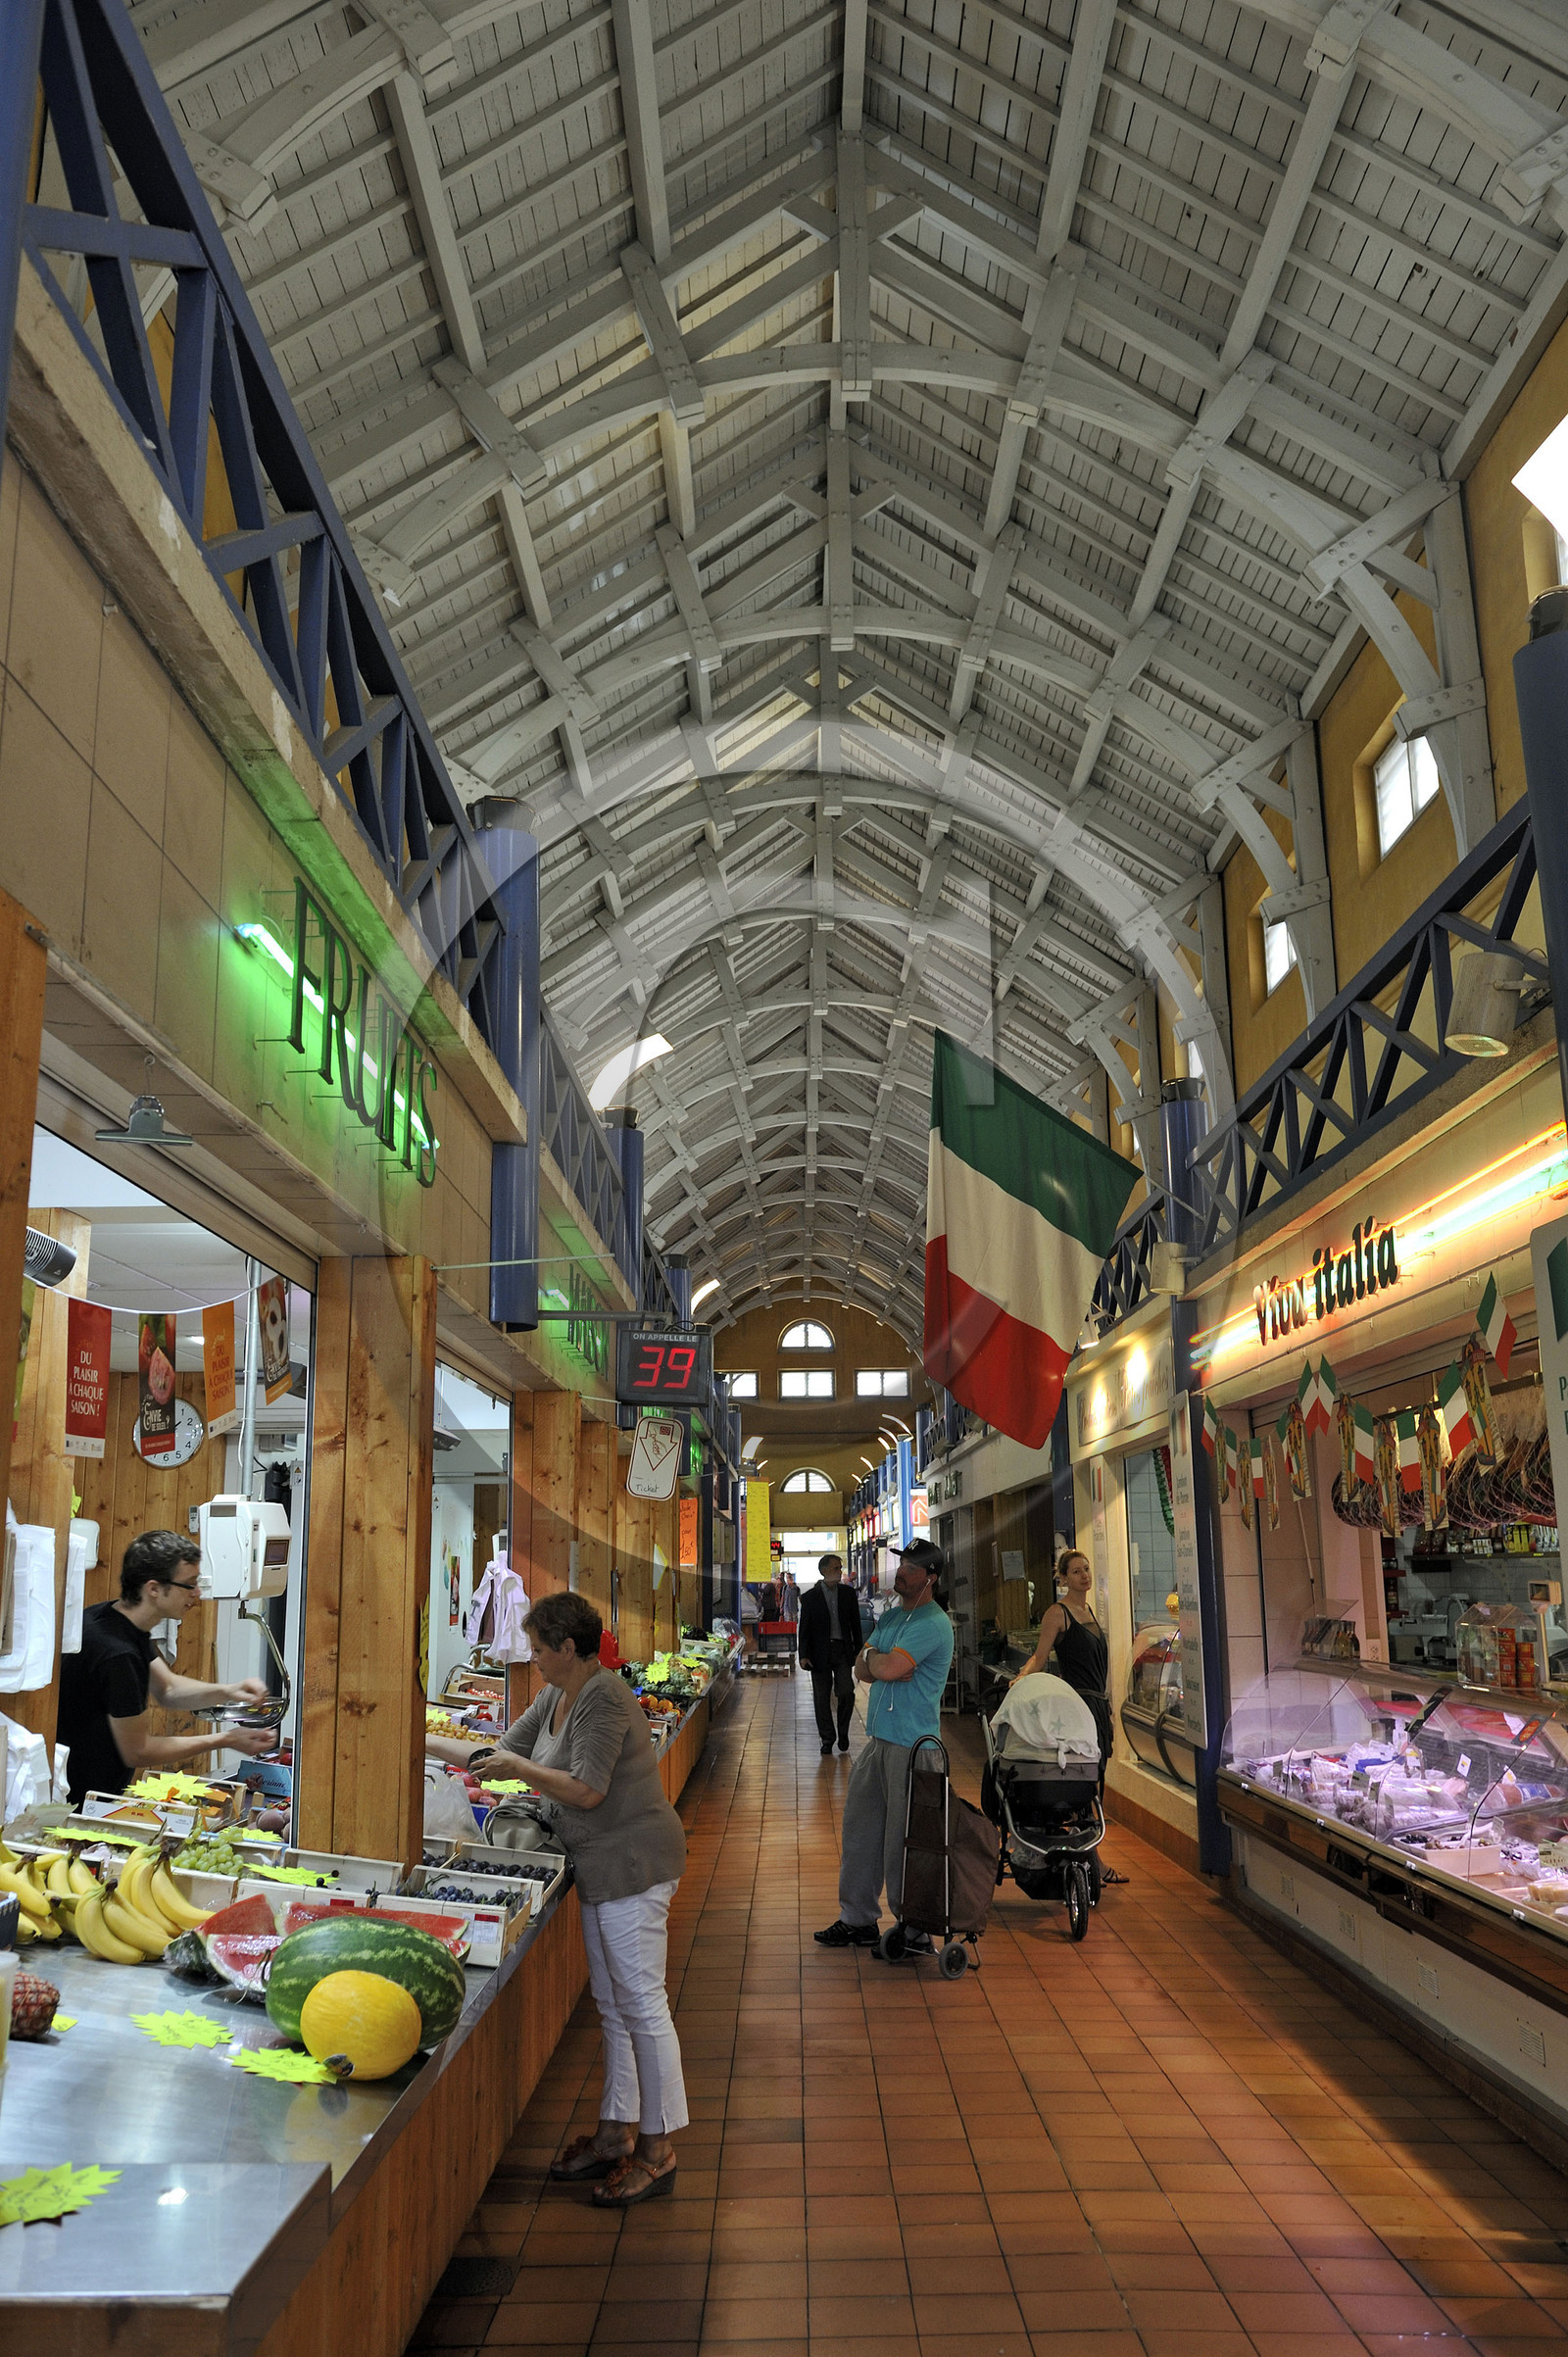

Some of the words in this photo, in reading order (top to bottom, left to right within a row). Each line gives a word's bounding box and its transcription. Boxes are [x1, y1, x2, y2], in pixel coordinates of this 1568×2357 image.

[287, 876, 437, 1189] FRUITS
[1312, 1215, 1401, 1320] italia
[647, 1333, 685, 1342] APPELLE
[80, 1350, 92, 1365] DU
[74, 1366, 99, 1383] PLAISIR
[632, 1346, 697, 1389] 39
[73, 1383, 104, 1401] CHAQUE
[71, 1399, 96, 1416] SAISON
[186, 1417, 193, 1426] 2
[184, 1441, 191, 1449] 4
[163, 1453, 170, 1462] 6
[636, 1484, 661, 1494] Ticket
